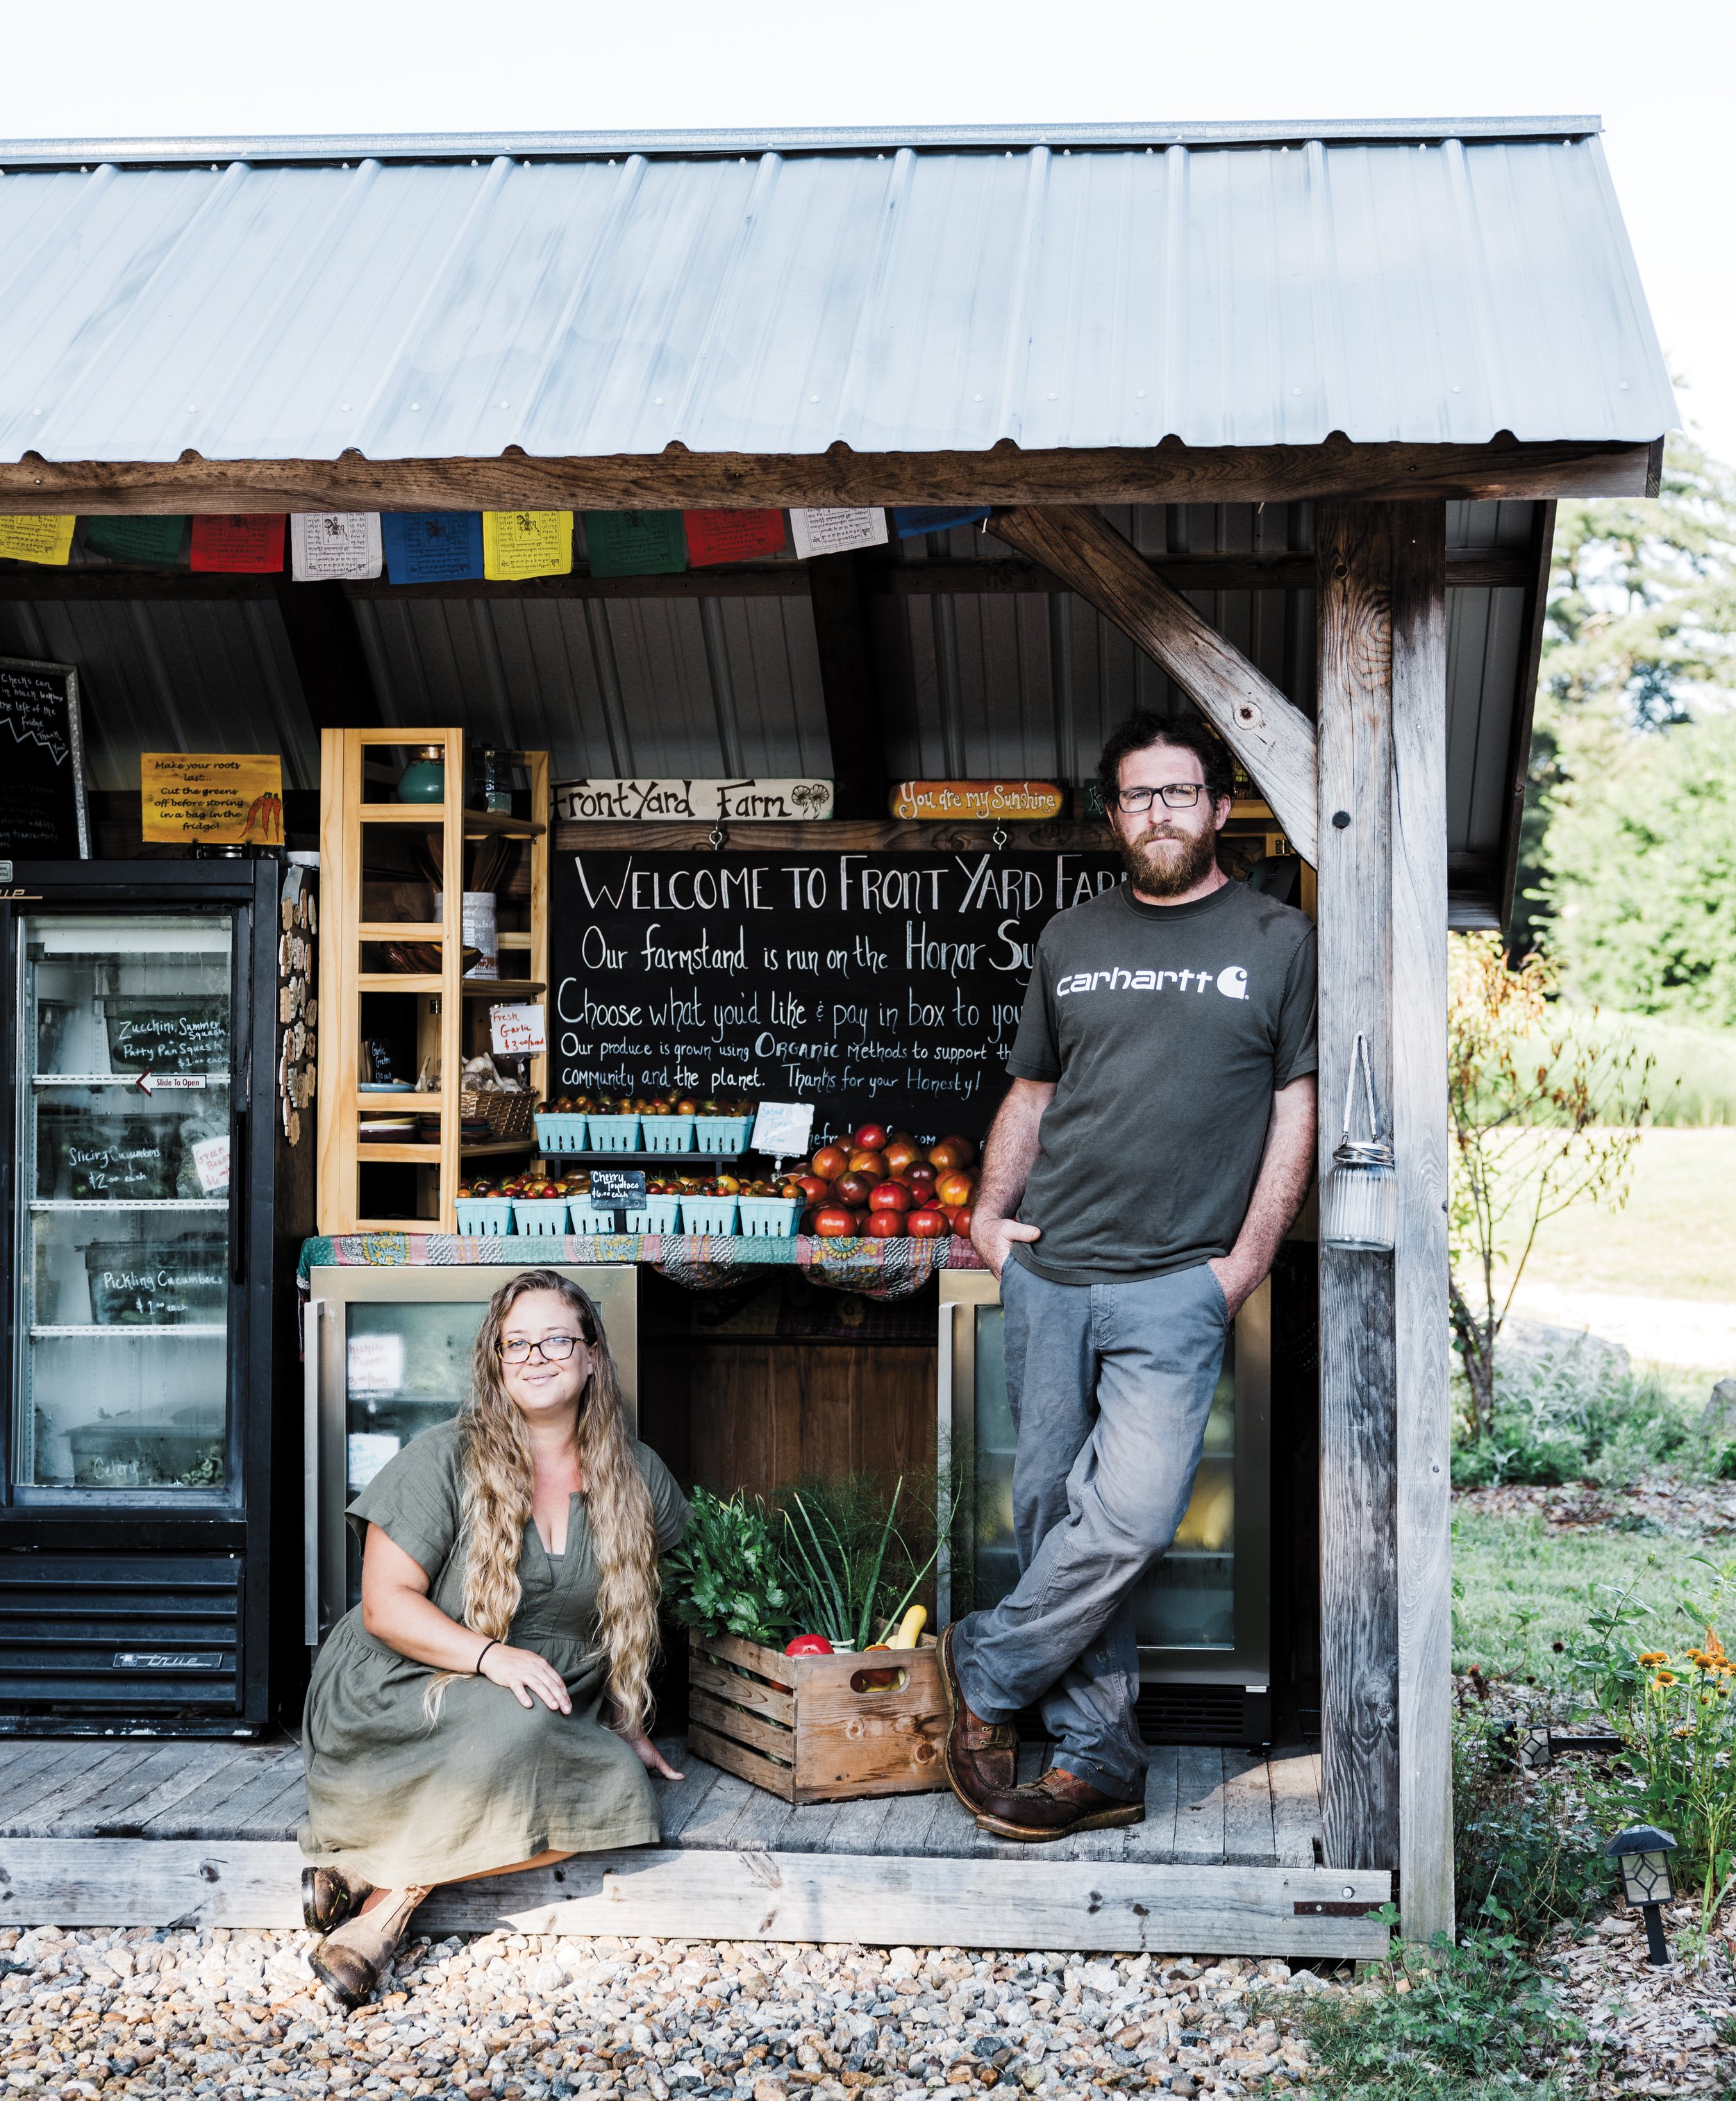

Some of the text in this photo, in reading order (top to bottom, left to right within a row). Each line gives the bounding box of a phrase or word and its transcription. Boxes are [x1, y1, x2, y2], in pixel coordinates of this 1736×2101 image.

[1, 674, 52, 690] Checks can
[14, 690, 38, 701] black
[15, 701, 30, 718] left
[33, 704, 40, 713] of
[21, 717, 44, 731] fridge
[37, 730, 62, 740] Thank
[154, 799, 244, 808] off before storing
[717, 779, 792, 820] Farm
[898, 781, 937, 820] You
[939, 787, 962, 811] are
[965, 790, 990, 819] my
[991, 782, 1055, 813] Sunshine
[185, 811, 208, 820] bag
[182, 822, 219, 833] fridge!
[575, 854, 1129, 919] WELCOME TO FRONT YARD FAR
[582, 925, 628, 969] Our
[641, 923, 748, 977] farmstand
[764, 947, 778, 970] is
[786, 949, 819, 976] run
[826, 949, 849, 979] on
[852, 935, 887, 974] the
[906, 920, 987, 979] Honor
[1056, 967, 1213, 997] carhartt
[493, 1011, 520, 1022] Fresh
[558, 977, 642, 1030] Choose
[649, 986, 706, 1033] what
[771, 990, 807, 1029] like
[833, 1004, 868, 1046] pay
[879, 1003, 898, 1034] in
[909, 986, 944, 1027] box
[952, 986, 979, 1027] to
[119, 1018, 219, 1040] Zucchini, Summer
[500, 1024, 532, 1038] Garlic
[124, 1041, 222, 1061] Patty Pan Squash
[560, 1032, 593, 1057] Our
[600, 1036, 653, 1061] produce
[660, 1041, 670, 1056] is
[674, 1043, 712, 1063] grown
[719, 1043, 749, 1062] using
[912, 1041, 928, 1059] to
[934, 1044, 987, 1065] support
[178, 1058, 203, 1069] $1.00
[183, 1079, 199, 1088] Open
[642, 1065, 671, 1088] and
[674, 1065, 699, 1089] the
[711, 1067, 765, 1093] planet.
[781, 1063, 836, 1095] Thanks
[842, 1065, 865, 1091] for
[869, 1077, 899, 1098] your
[907, 1068, 981, 1101] Honesty!
[761, 1105, 784, 1117] Small
[69, 1147, 108, 1168] Slicing
[197, 1147, 224, 1165] Green
[89, 1171, 147, 1189] $2.00 each
[593, 1171, 624, 1184] Cherry
[592, 1188, 610, 1198] $6.00
[608, 1181, 639, 1193] Tomatoes
[104, 1270, 222, 1292] Pickling Cucumbers
[349, 1343, 384, 1355] hishito
[353, 1356, 389, 1368] Peppers
[94, 1457, 140, 1484] Celery
